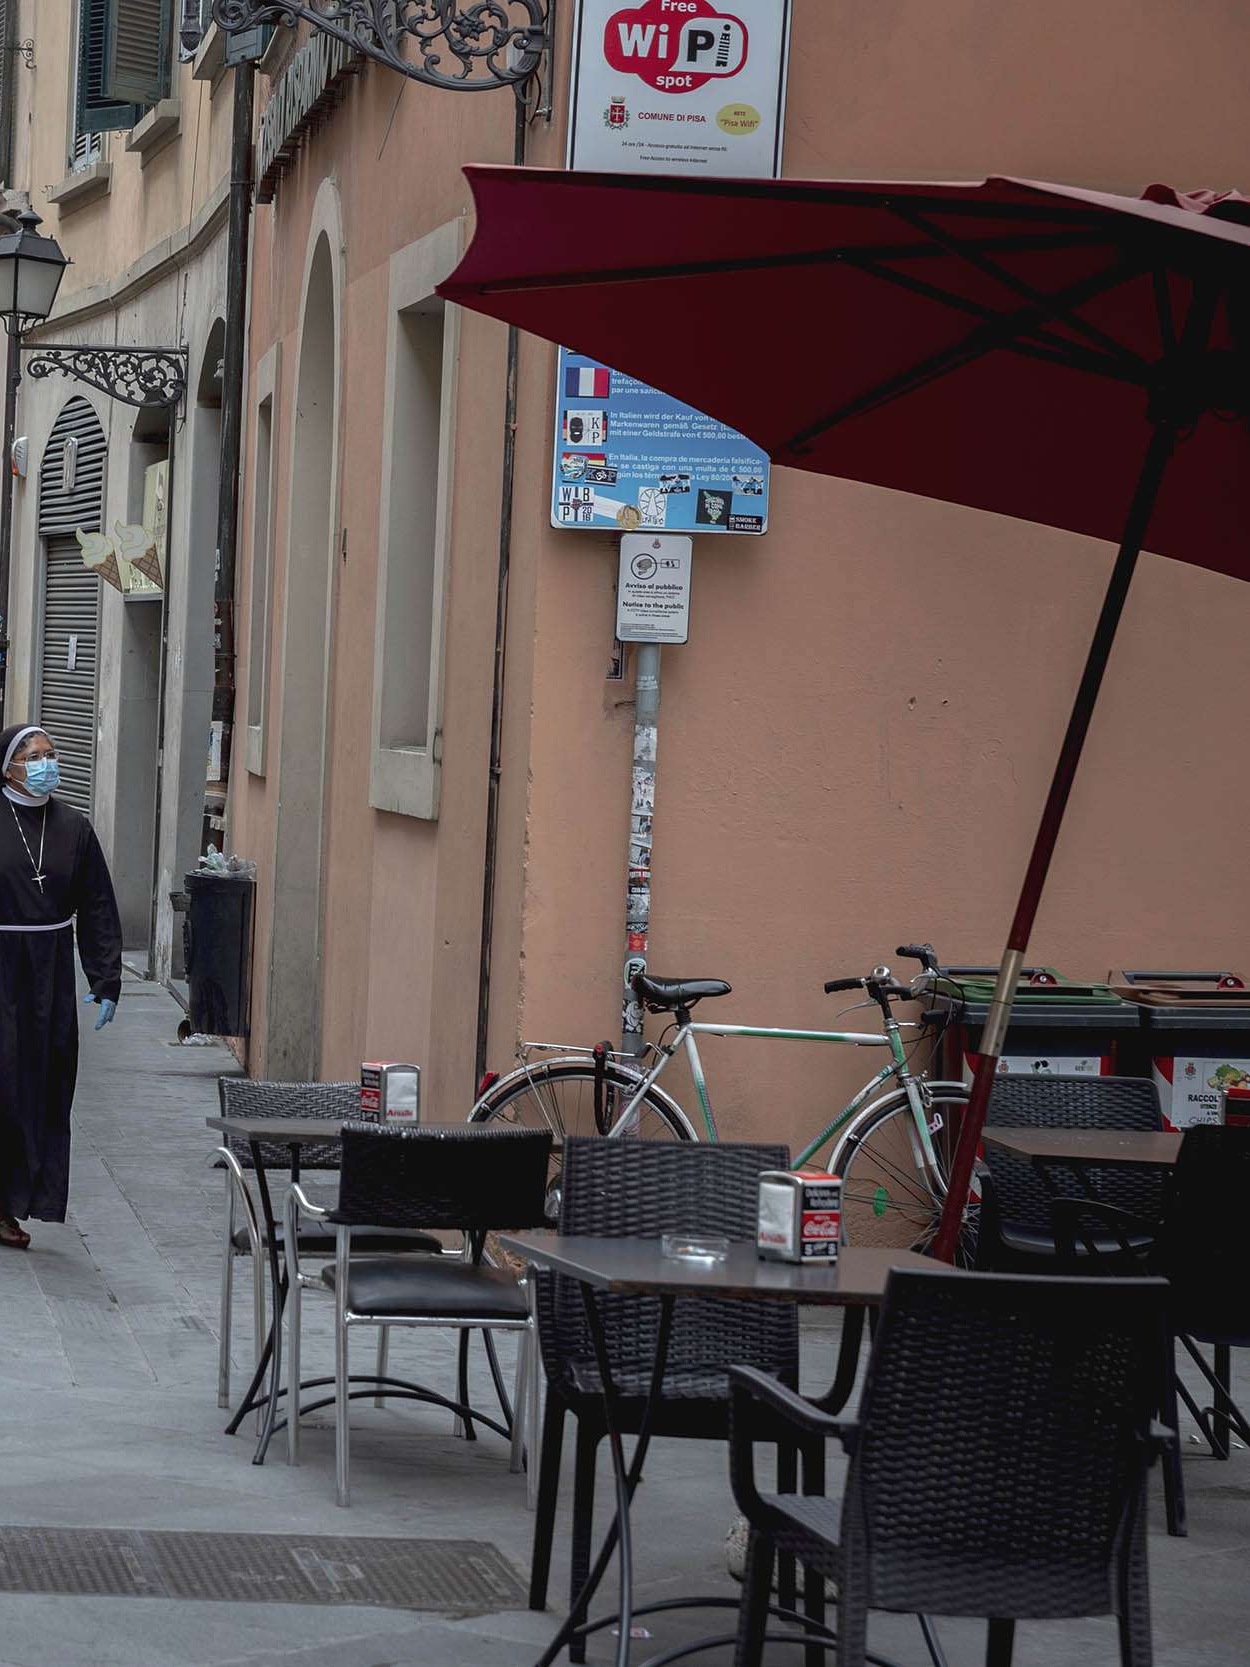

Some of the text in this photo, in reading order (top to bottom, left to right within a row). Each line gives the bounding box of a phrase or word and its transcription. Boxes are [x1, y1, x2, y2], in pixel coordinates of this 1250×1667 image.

[661, 0, 697, 13] Free
[656, 74, 692, 88] spot
[638, 112, 706, 123] COMUNE DI PISA
